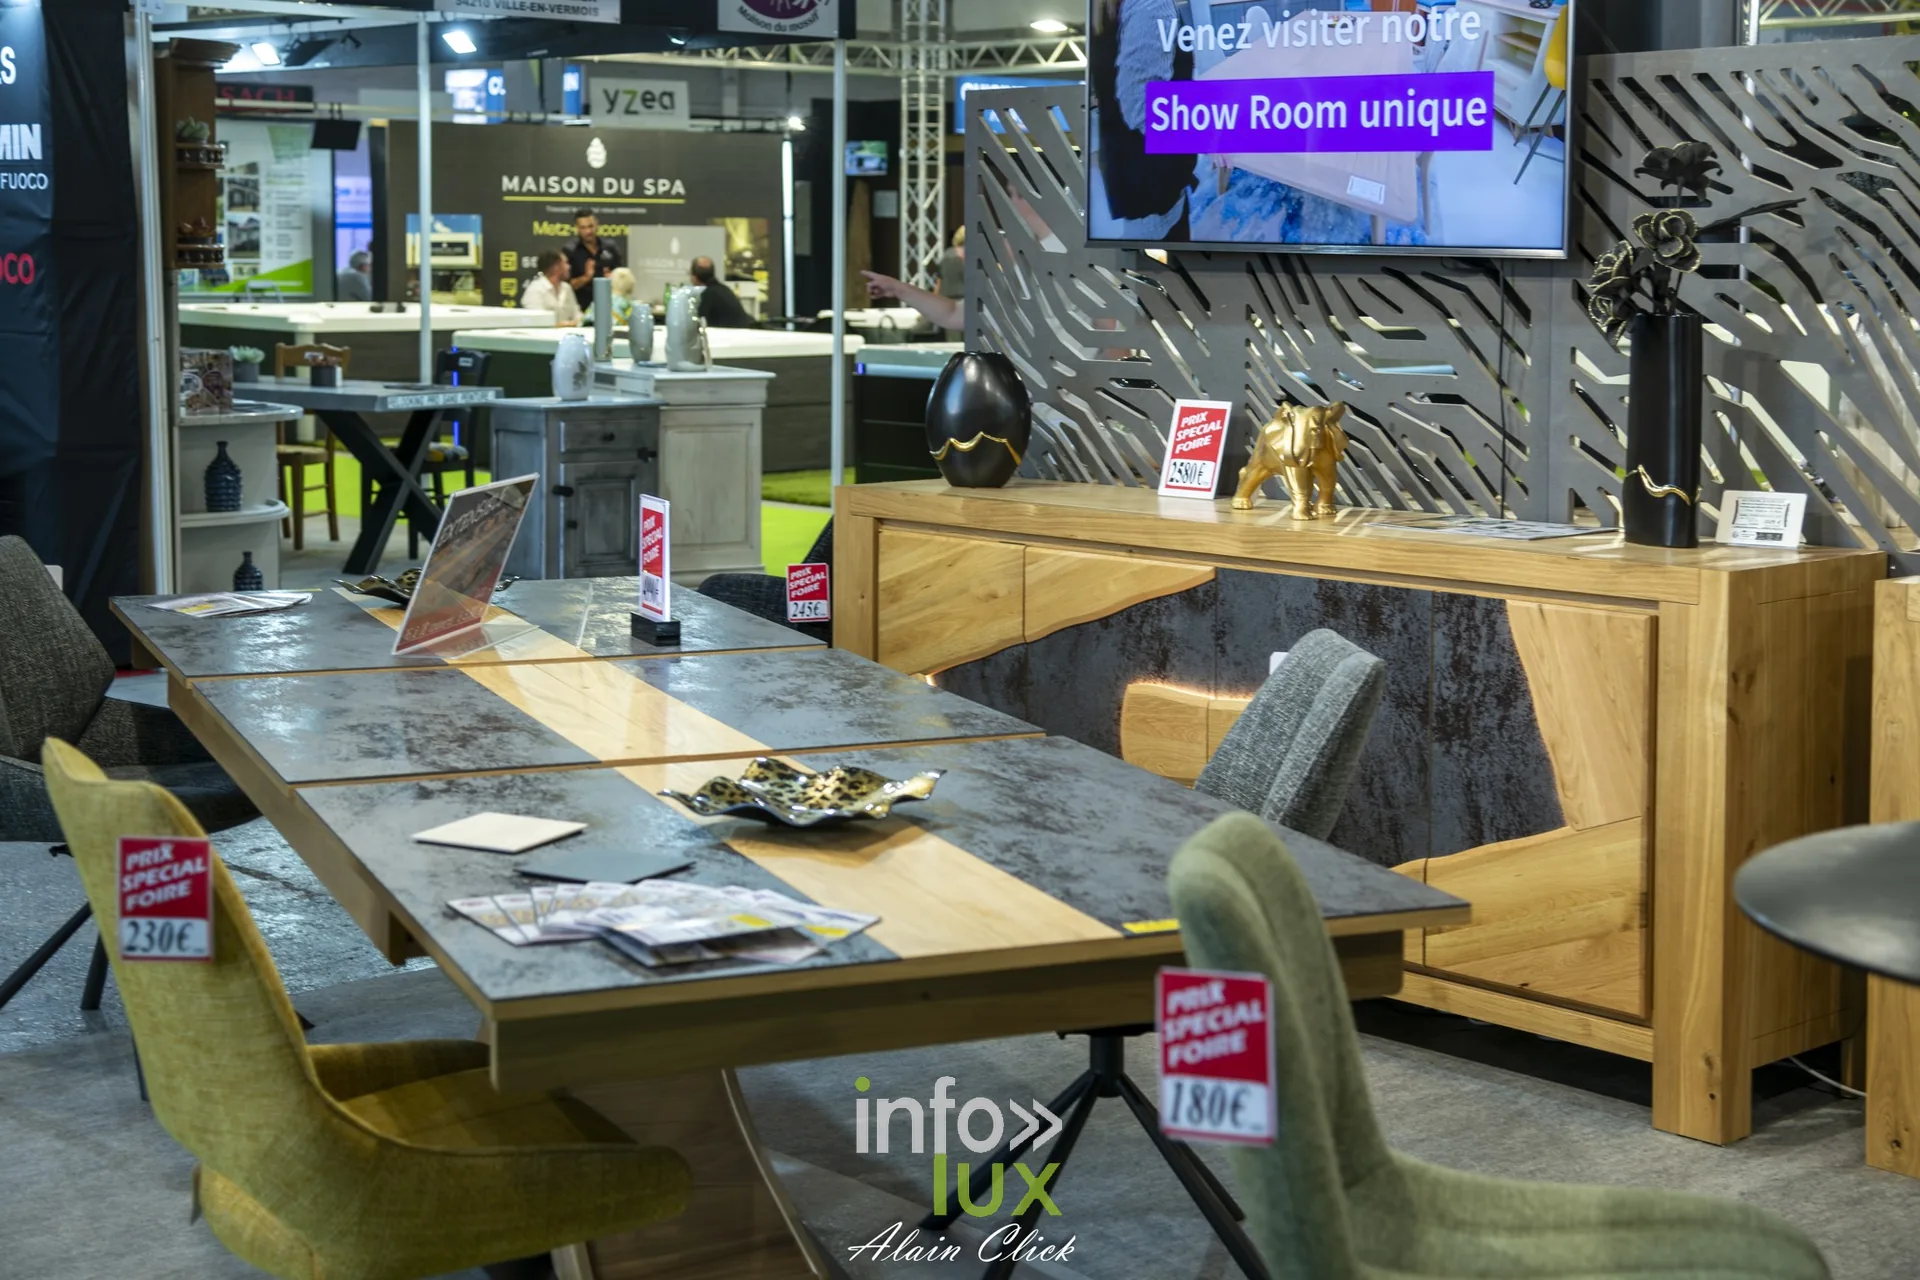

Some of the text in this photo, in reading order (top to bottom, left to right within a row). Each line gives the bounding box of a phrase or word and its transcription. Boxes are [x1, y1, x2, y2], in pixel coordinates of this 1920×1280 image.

[495, 0, 599, 17] VILLE-EN-VERMOIS
[737, 5, 773, 31] Maison
[774, 22, 788, 32] du
[1158, 8, 1482, 53] Venez visiter notre
[603, 88, 675, 115] yzea
[1150, 89, 1488, 137] Show Room unique
[0, 172, 49, 190] FUOCO
[501, 175, 687, 196] MAISON DU SPA
[0, 252, 36, 285] CO
[1176, 420, 1222, 441] SPECIAL
[1181, 411, 1208, 428] PRIX
[1175, 435, 1212, 454] FOIRE
[643, 514, 656, 533] PRIX
[642, 526, 664, 550] SPECIAL
[643, 544, 660, 565] FOIRE
[789, 571, 827, 590] SPECIAL
[790, 566, 812, 581] PRIX
[791, 583, 820, 598] FOIRE
[792, 601, 821, 618] 245€
[126, 842, 175, 871] PRIX
[122, 857, 207, 893] SPECIAL
[126, 880, 192, 912] FOIRE
[124, 920, 194, 953] 230€
[1166, 979, 1226, 1016] PRIX
[1163, 997, 1265, 1043] SPECIAL
[1167, 1028, 1248, 1069] FOIRE
[1170, 1080, 1252, 1130] 180€
